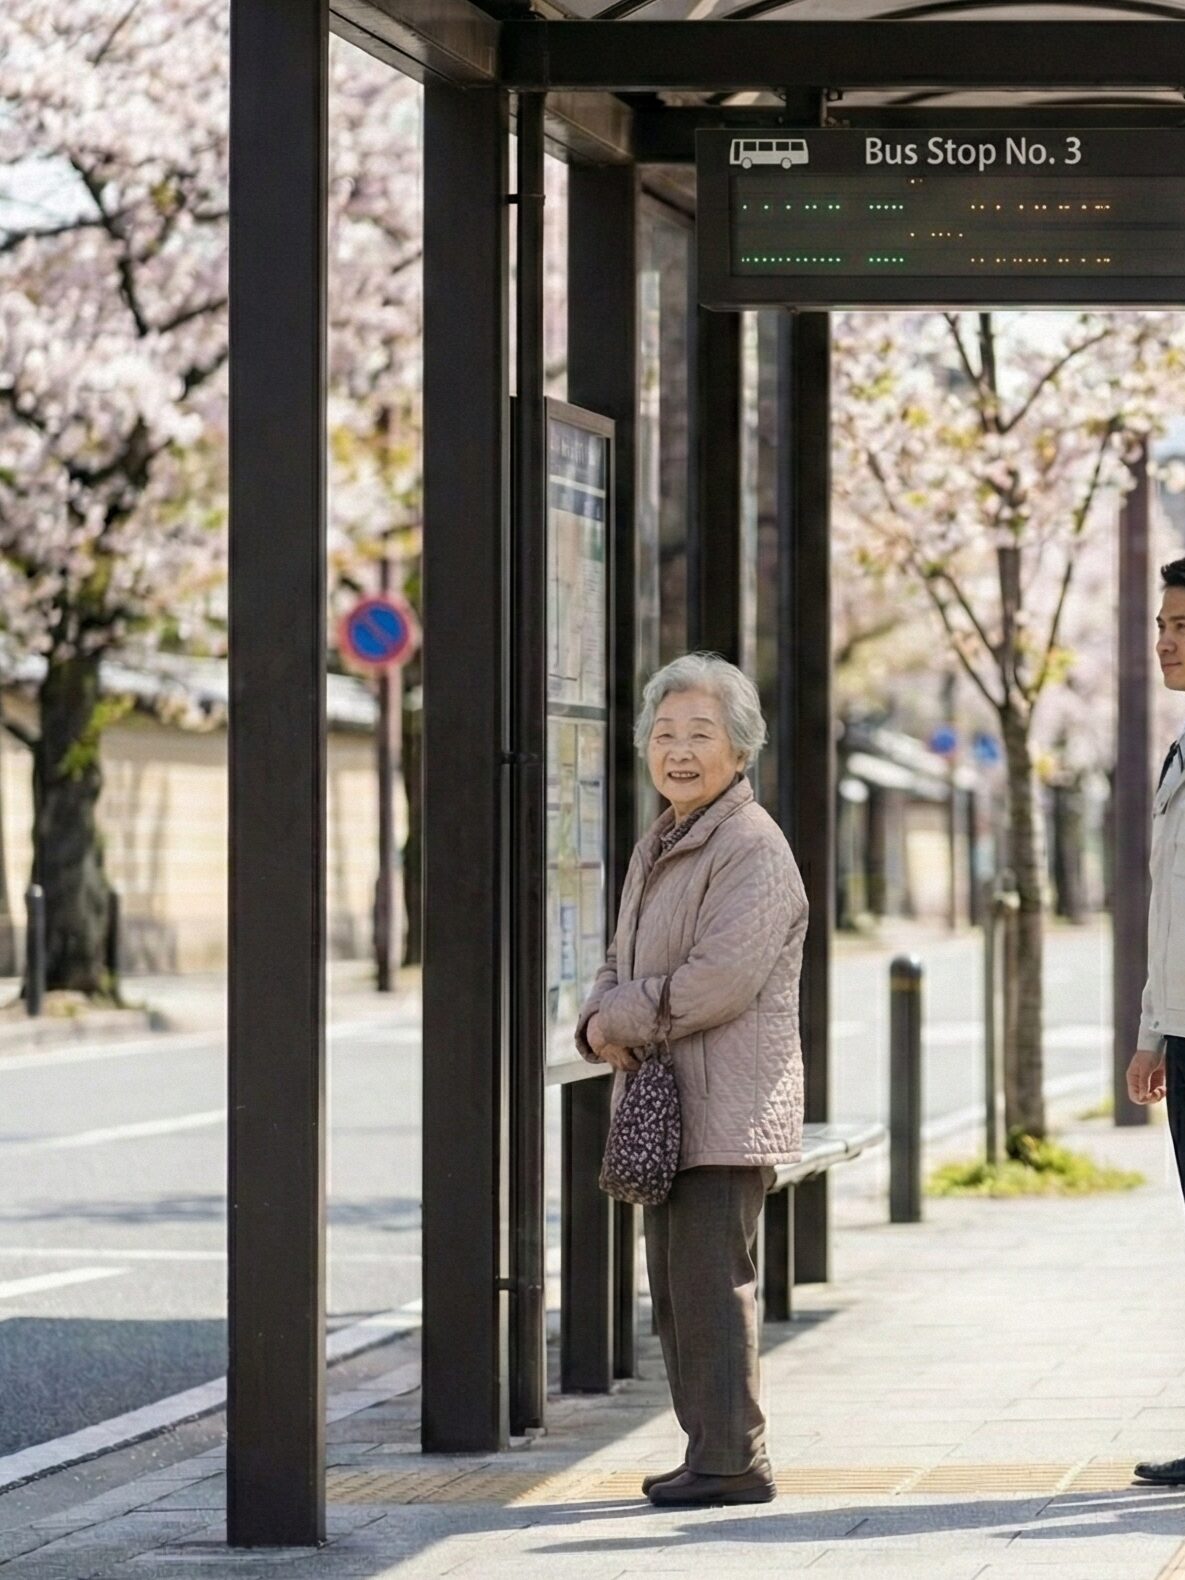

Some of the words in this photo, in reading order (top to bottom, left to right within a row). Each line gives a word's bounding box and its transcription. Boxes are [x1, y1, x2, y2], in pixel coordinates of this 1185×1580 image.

[865, 137, 918, 166] Bus
[927, 136, 996, 172] Stop
[1006, 137, 1055, 166] No.
[1064, 136, 1082, 166] 3
